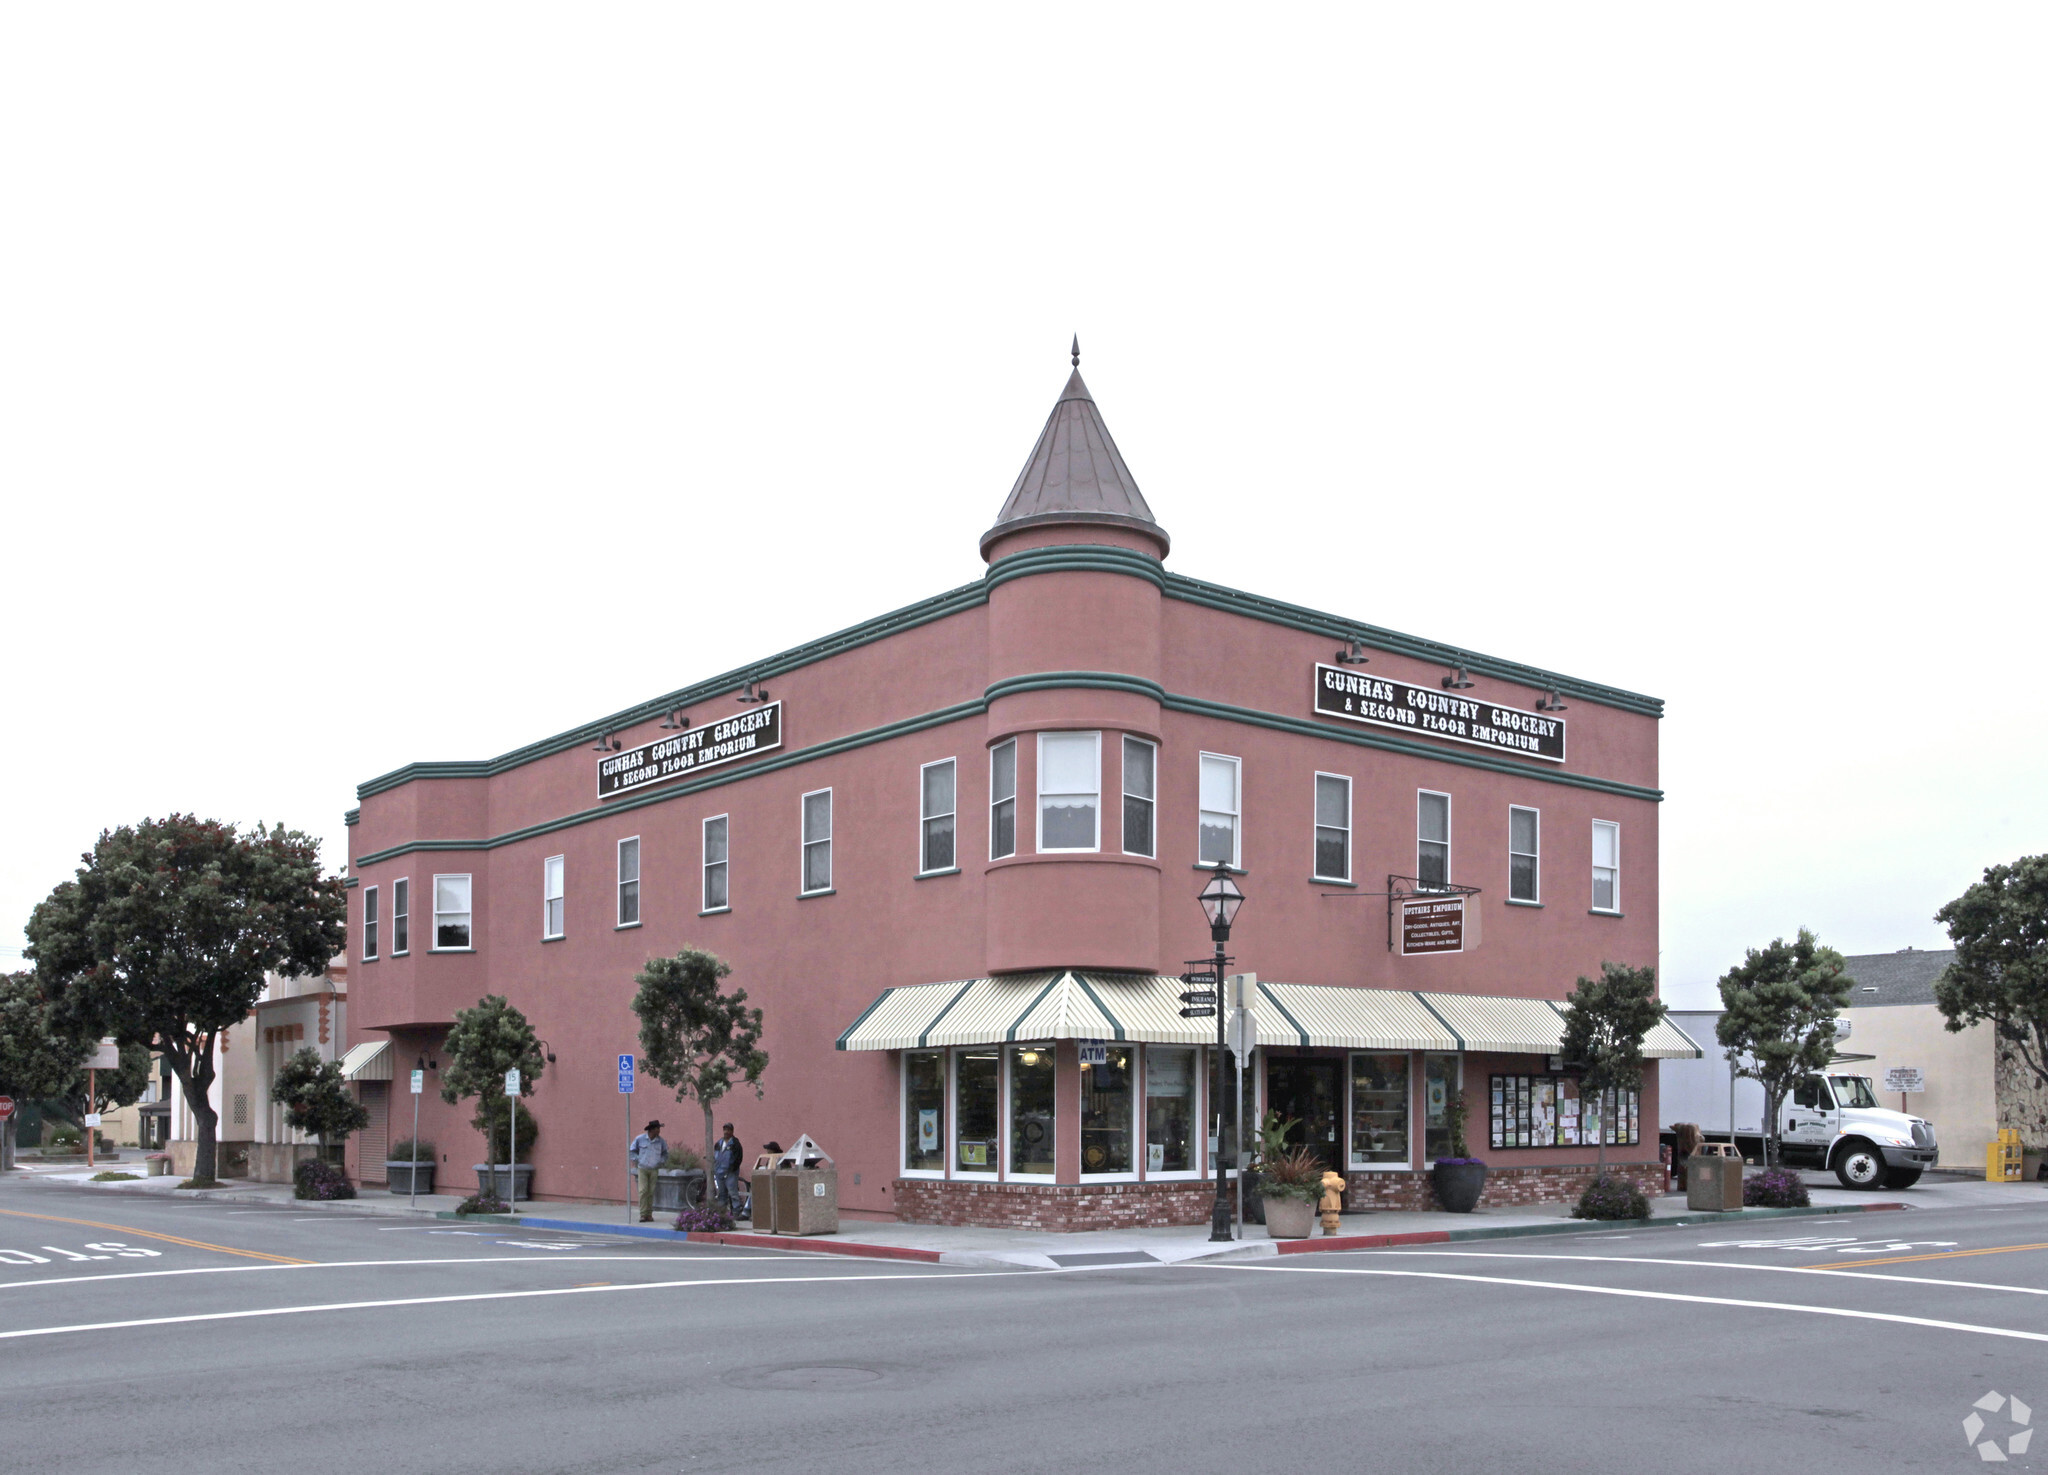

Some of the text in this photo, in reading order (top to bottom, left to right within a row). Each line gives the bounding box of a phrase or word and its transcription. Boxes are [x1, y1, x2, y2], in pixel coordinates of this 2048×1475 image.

[1325, 671, 1557, 738] CUNHA'S COUNTRY GROCERY
[1344, 697, 1540, 752] & SECOND FLOOR EMPORIUM
[602, 708, 773, 777] CUNHA'S COUNTRY GROCERY
[622, 764, 659, 786] SECOND
[662, 753, 695, 774] FLOOR
[698, 733, 757, 764] EMPORIUM
[1404, 903, 1462, 915] UPSTAIRS EMPORIUM
[508, 1073, 517, 1082] 15
[1080, 1047, 1105, 1061] ATM
